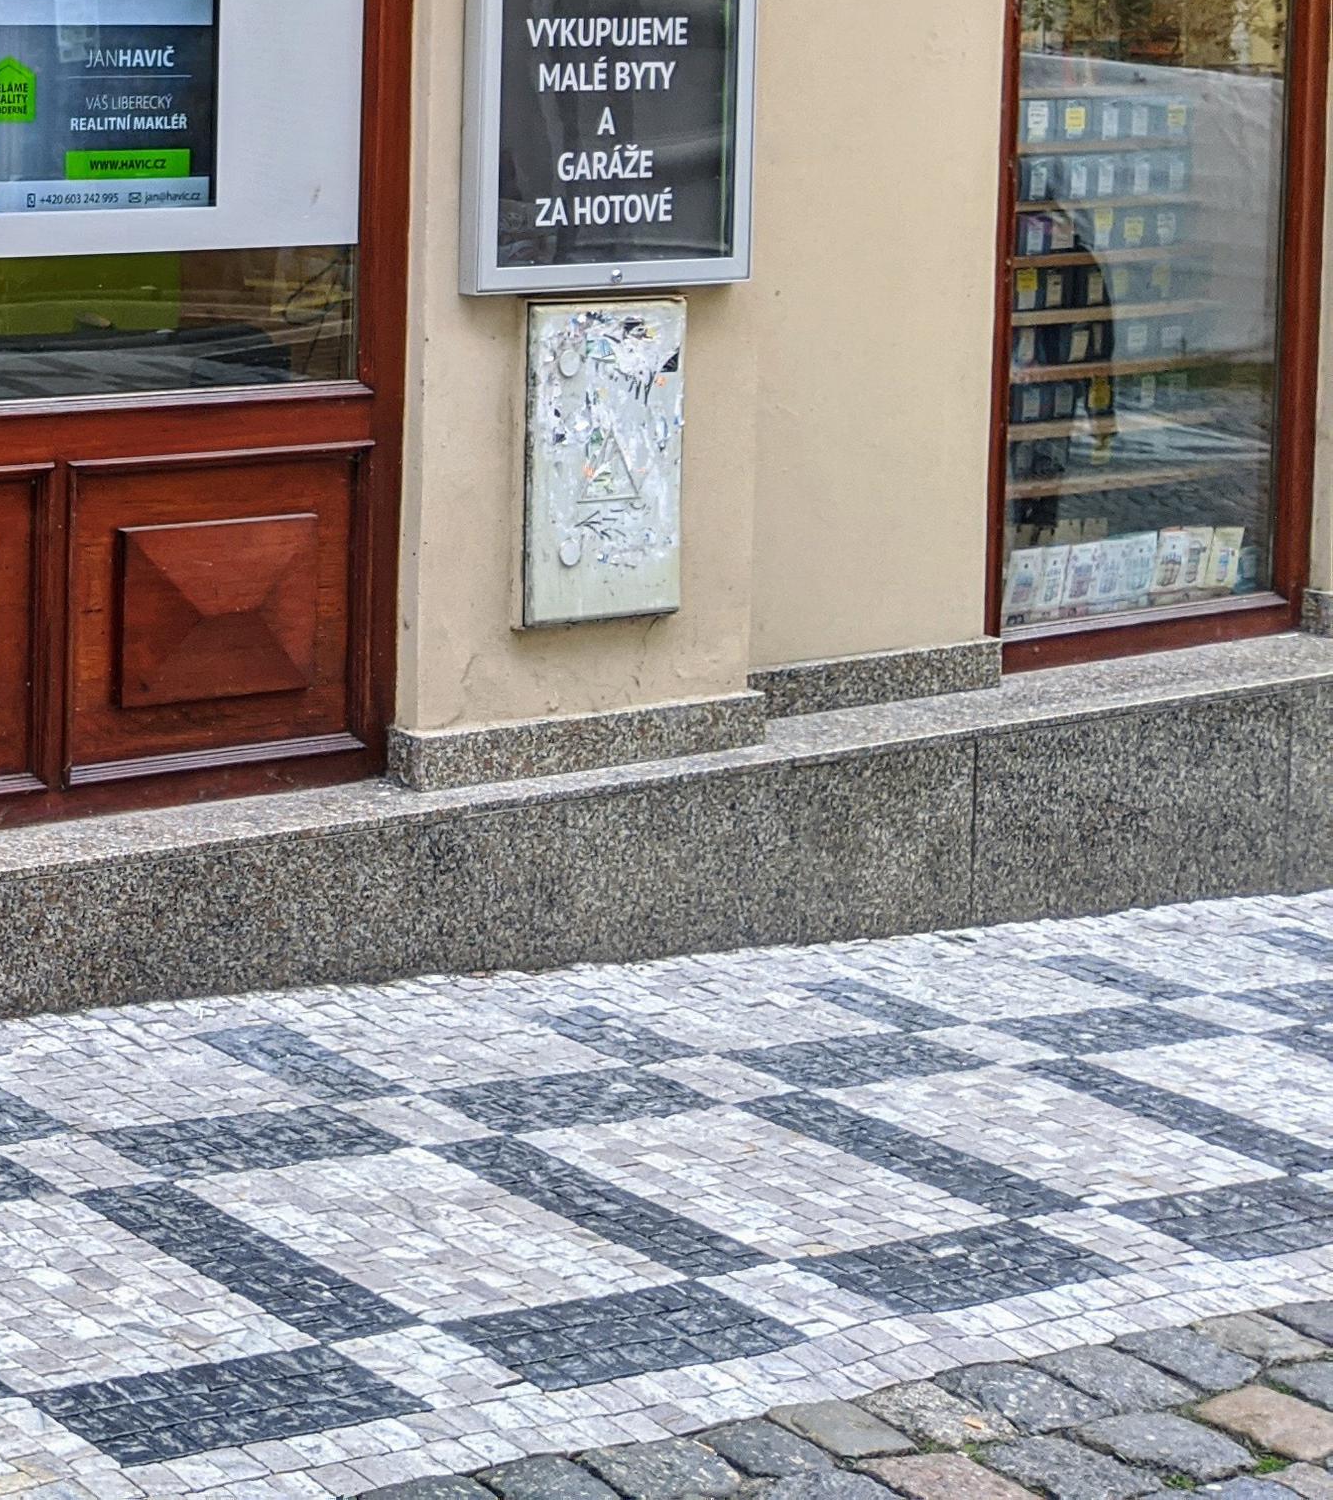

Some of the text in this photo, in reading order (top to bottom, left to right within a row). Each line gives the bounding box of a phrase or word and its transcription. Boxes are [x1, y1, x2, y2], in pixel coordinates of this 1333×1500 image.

[526, 17, 688, 47] VYKUPUJEME
[539, 56, 676, 92] MALÉ BYTY
[86, 93, 173, 110] VÁŠ LIBERECKÝ
[70, 113, 187, 131] REALITNÍ MAKLÉŘ
[597, 106, 616, 135] A
[90, 159, 166, 171] WWW.HAVIC.CZ
[557, 144, 654, 181] GARÁŽE
[40, 190, 201, 204] +420 603 242 995 jan@havic.cz
[535, 187, 673, 227] ZA HOTOVÉ
